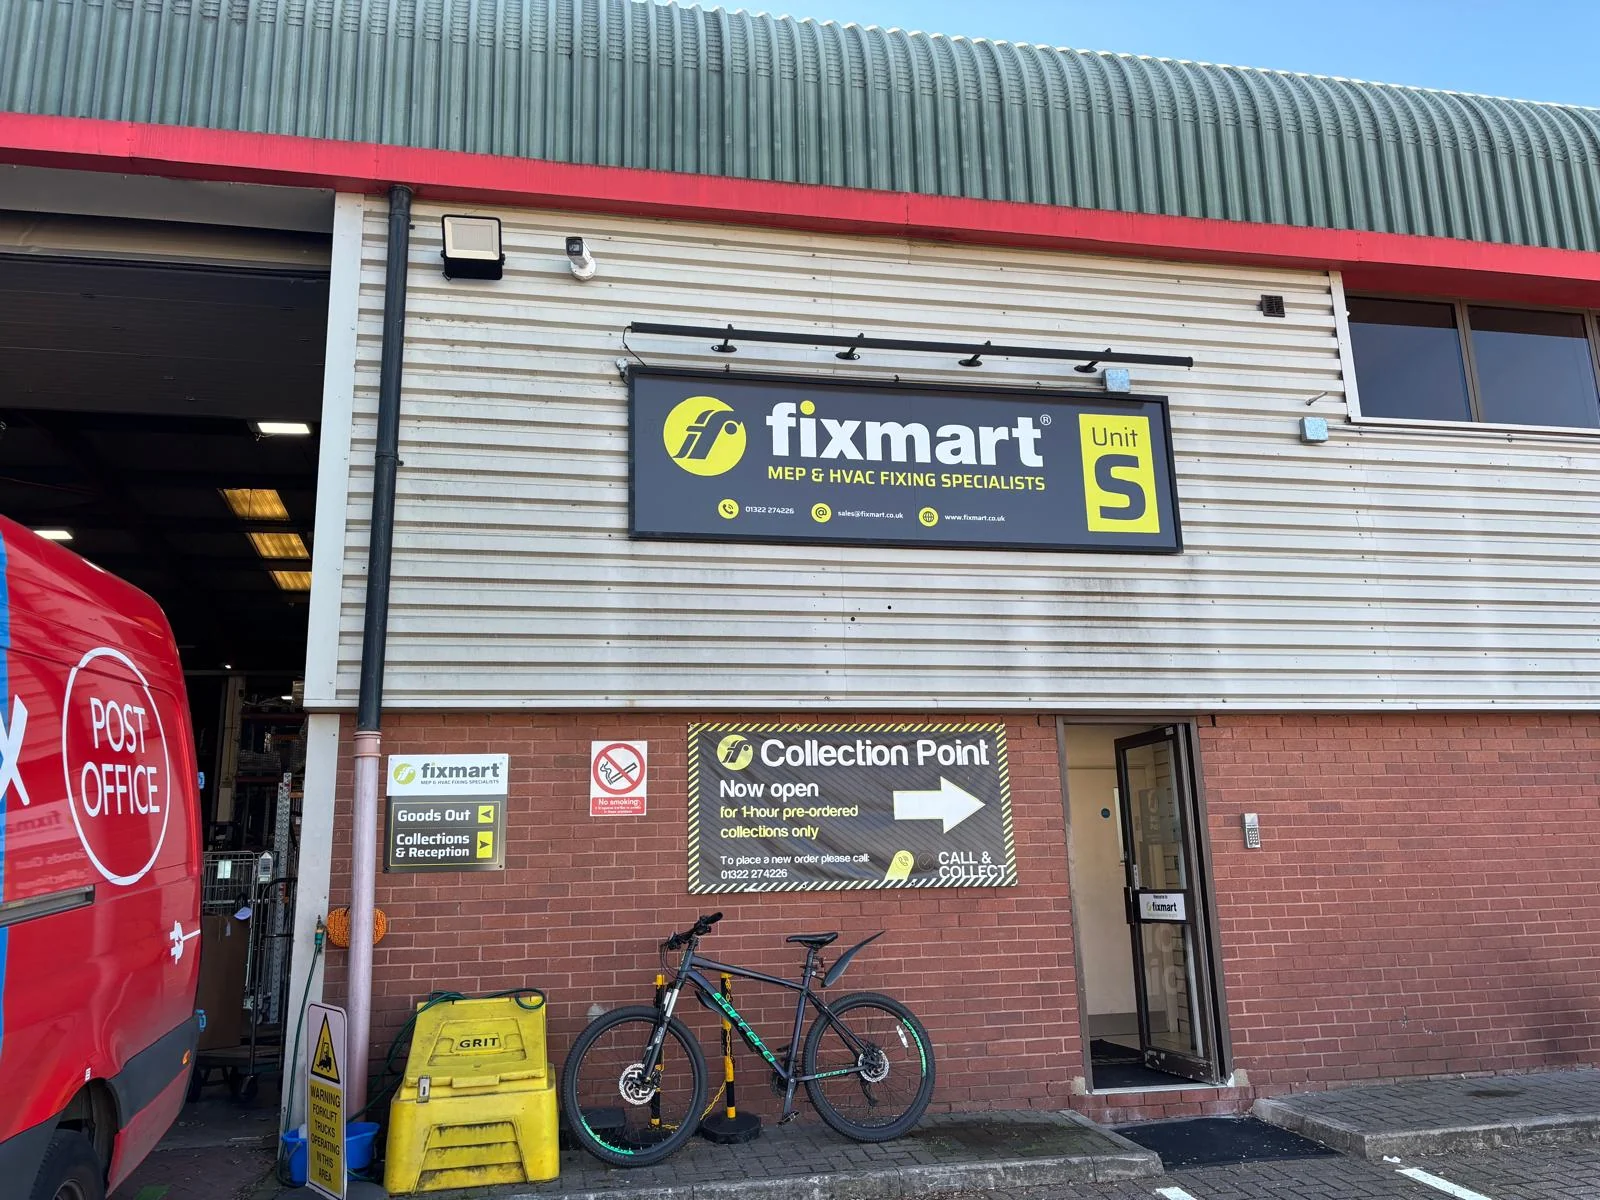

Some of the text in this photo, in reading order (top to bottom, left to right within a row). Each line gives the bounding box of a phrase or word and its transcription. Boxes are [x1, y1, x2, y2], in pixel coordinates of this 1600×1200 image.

[1092, 426, 1138, 448] Unit
[767, 466, 1045, 491] MEP & HVAC FIXING SPECIALISTS
[1094, 453, 1146, 521] S
[745, 505, 766, 514] 01322
[944, 513, 1006, 522] www.fixmart.co.uk
[89, 697, 146, 753] POST
[760, 738, 990, 767] Collection Point
[421, 762, 500, 778] fixmart
[81, 761, 160, 818] OFFICE
[719, 779, 819, 802] Now open
[598, 797, 638, 807] No smoking
[397, 808, 471, 822] Goods Out
[720, 804, 858, 820] for 1-hour pre-ordered
[396, 833, 470, 846] Collections
[720, 825, 819, 840] collections only
[395, 846, 470, 860] & Reception
[720, 856, 734, 865] To
[735, 855, 761, 867] place
[771, 856, 792, 864] new
[794, 854, 819, 864] order
[820, 854, 850, 865] please
[938, 851, 992, 865] CALL &
[720, 869, 788, 879] 01322 274226
[938, 864, 1008, 879] COLLECT
[1152, 901, 1178, 912] fixmart
[712, 992, 776, 1063] carrera
[459, 1037, 499, 1049] GRIT
[310, 1085, 341, 1108] WARNING
[312, 1103, 338, 1123] FORKLIFT
[314, 1120, 336, 1138] TRUCKS
[310, 1133, 340, 1156] OPERATING
[321, 1154, 334, 1169] THIS
[318, 1167, 332, 1182] AREA
